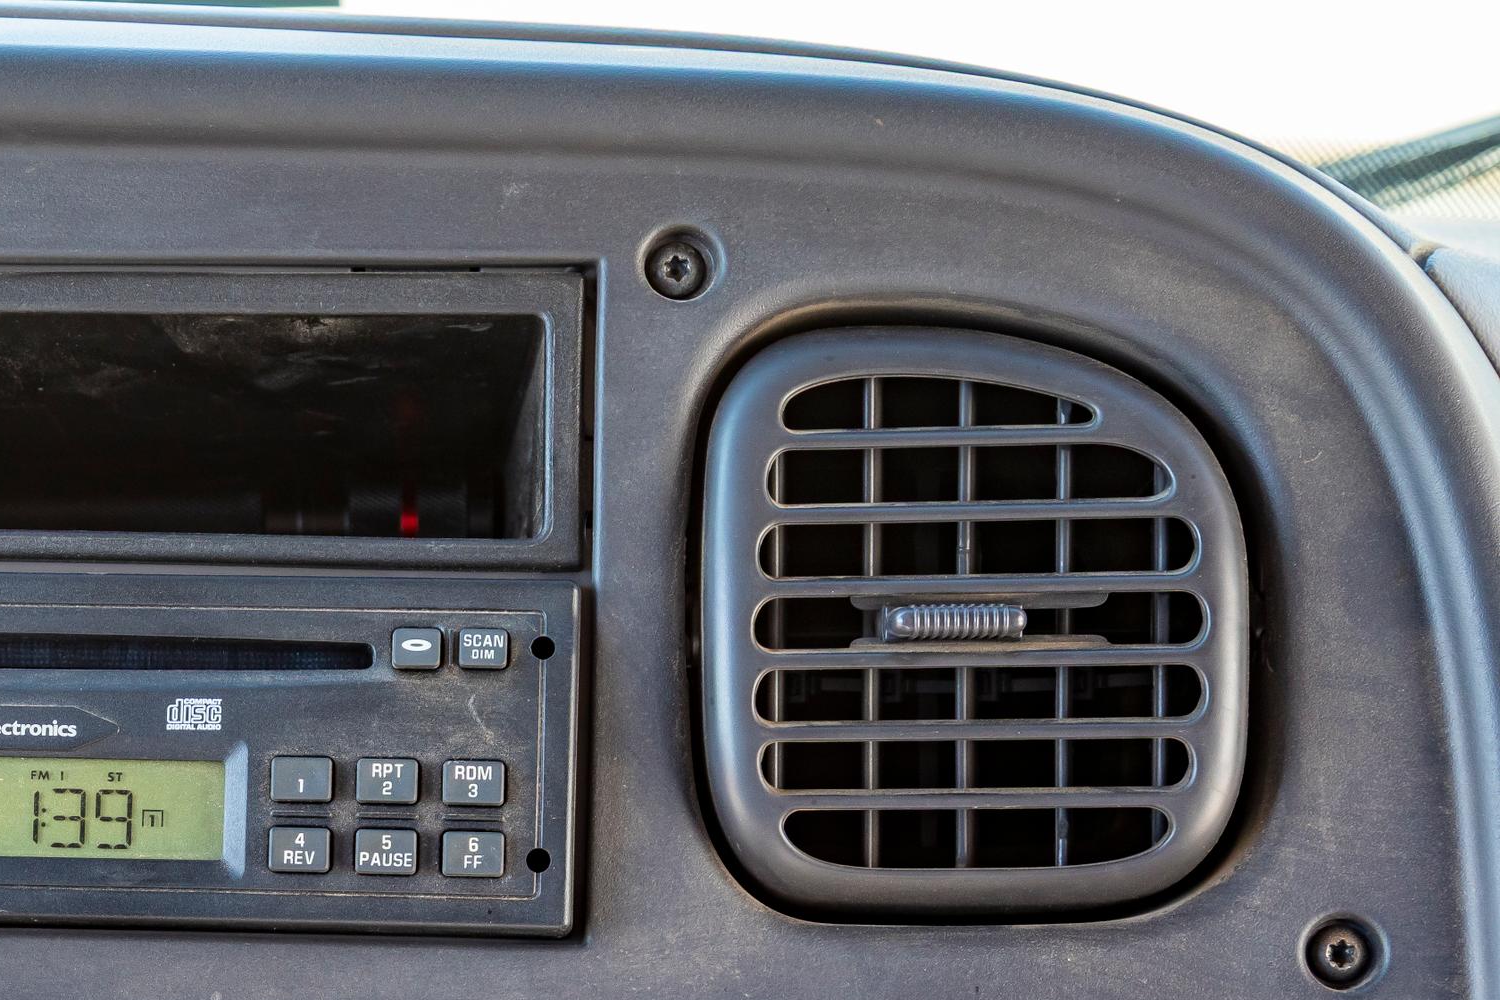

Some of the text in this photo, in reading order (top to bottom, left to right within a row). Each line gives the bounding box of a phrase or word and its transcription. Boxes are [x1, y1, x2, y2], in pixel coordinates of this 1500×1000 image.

[463, 634, 504, 647] SCAN
[471, 650, 495, 659] DIM
[166, 698, 222, 724] disc
[31, 770, 49, 781] FM
[108, 772, 123, 782] ST
[372, 763, 404, 778] RPT
[455, 765, 492, 781] RDM
[297, 778, 305, 793] 1
[382, 781, 392, 796] 2
[468, 784, 479, 797] 3
[32, 788, 134, 850] 1:39
[295, 832, 305, 848] 4
[381, 835, 393, 850] 5
[468, 837, 479, 852] 6
[283, 851, 315, 866] REV
[359, 853, 413, 868] PAUSE
[463, 855, 484, 869] FF
